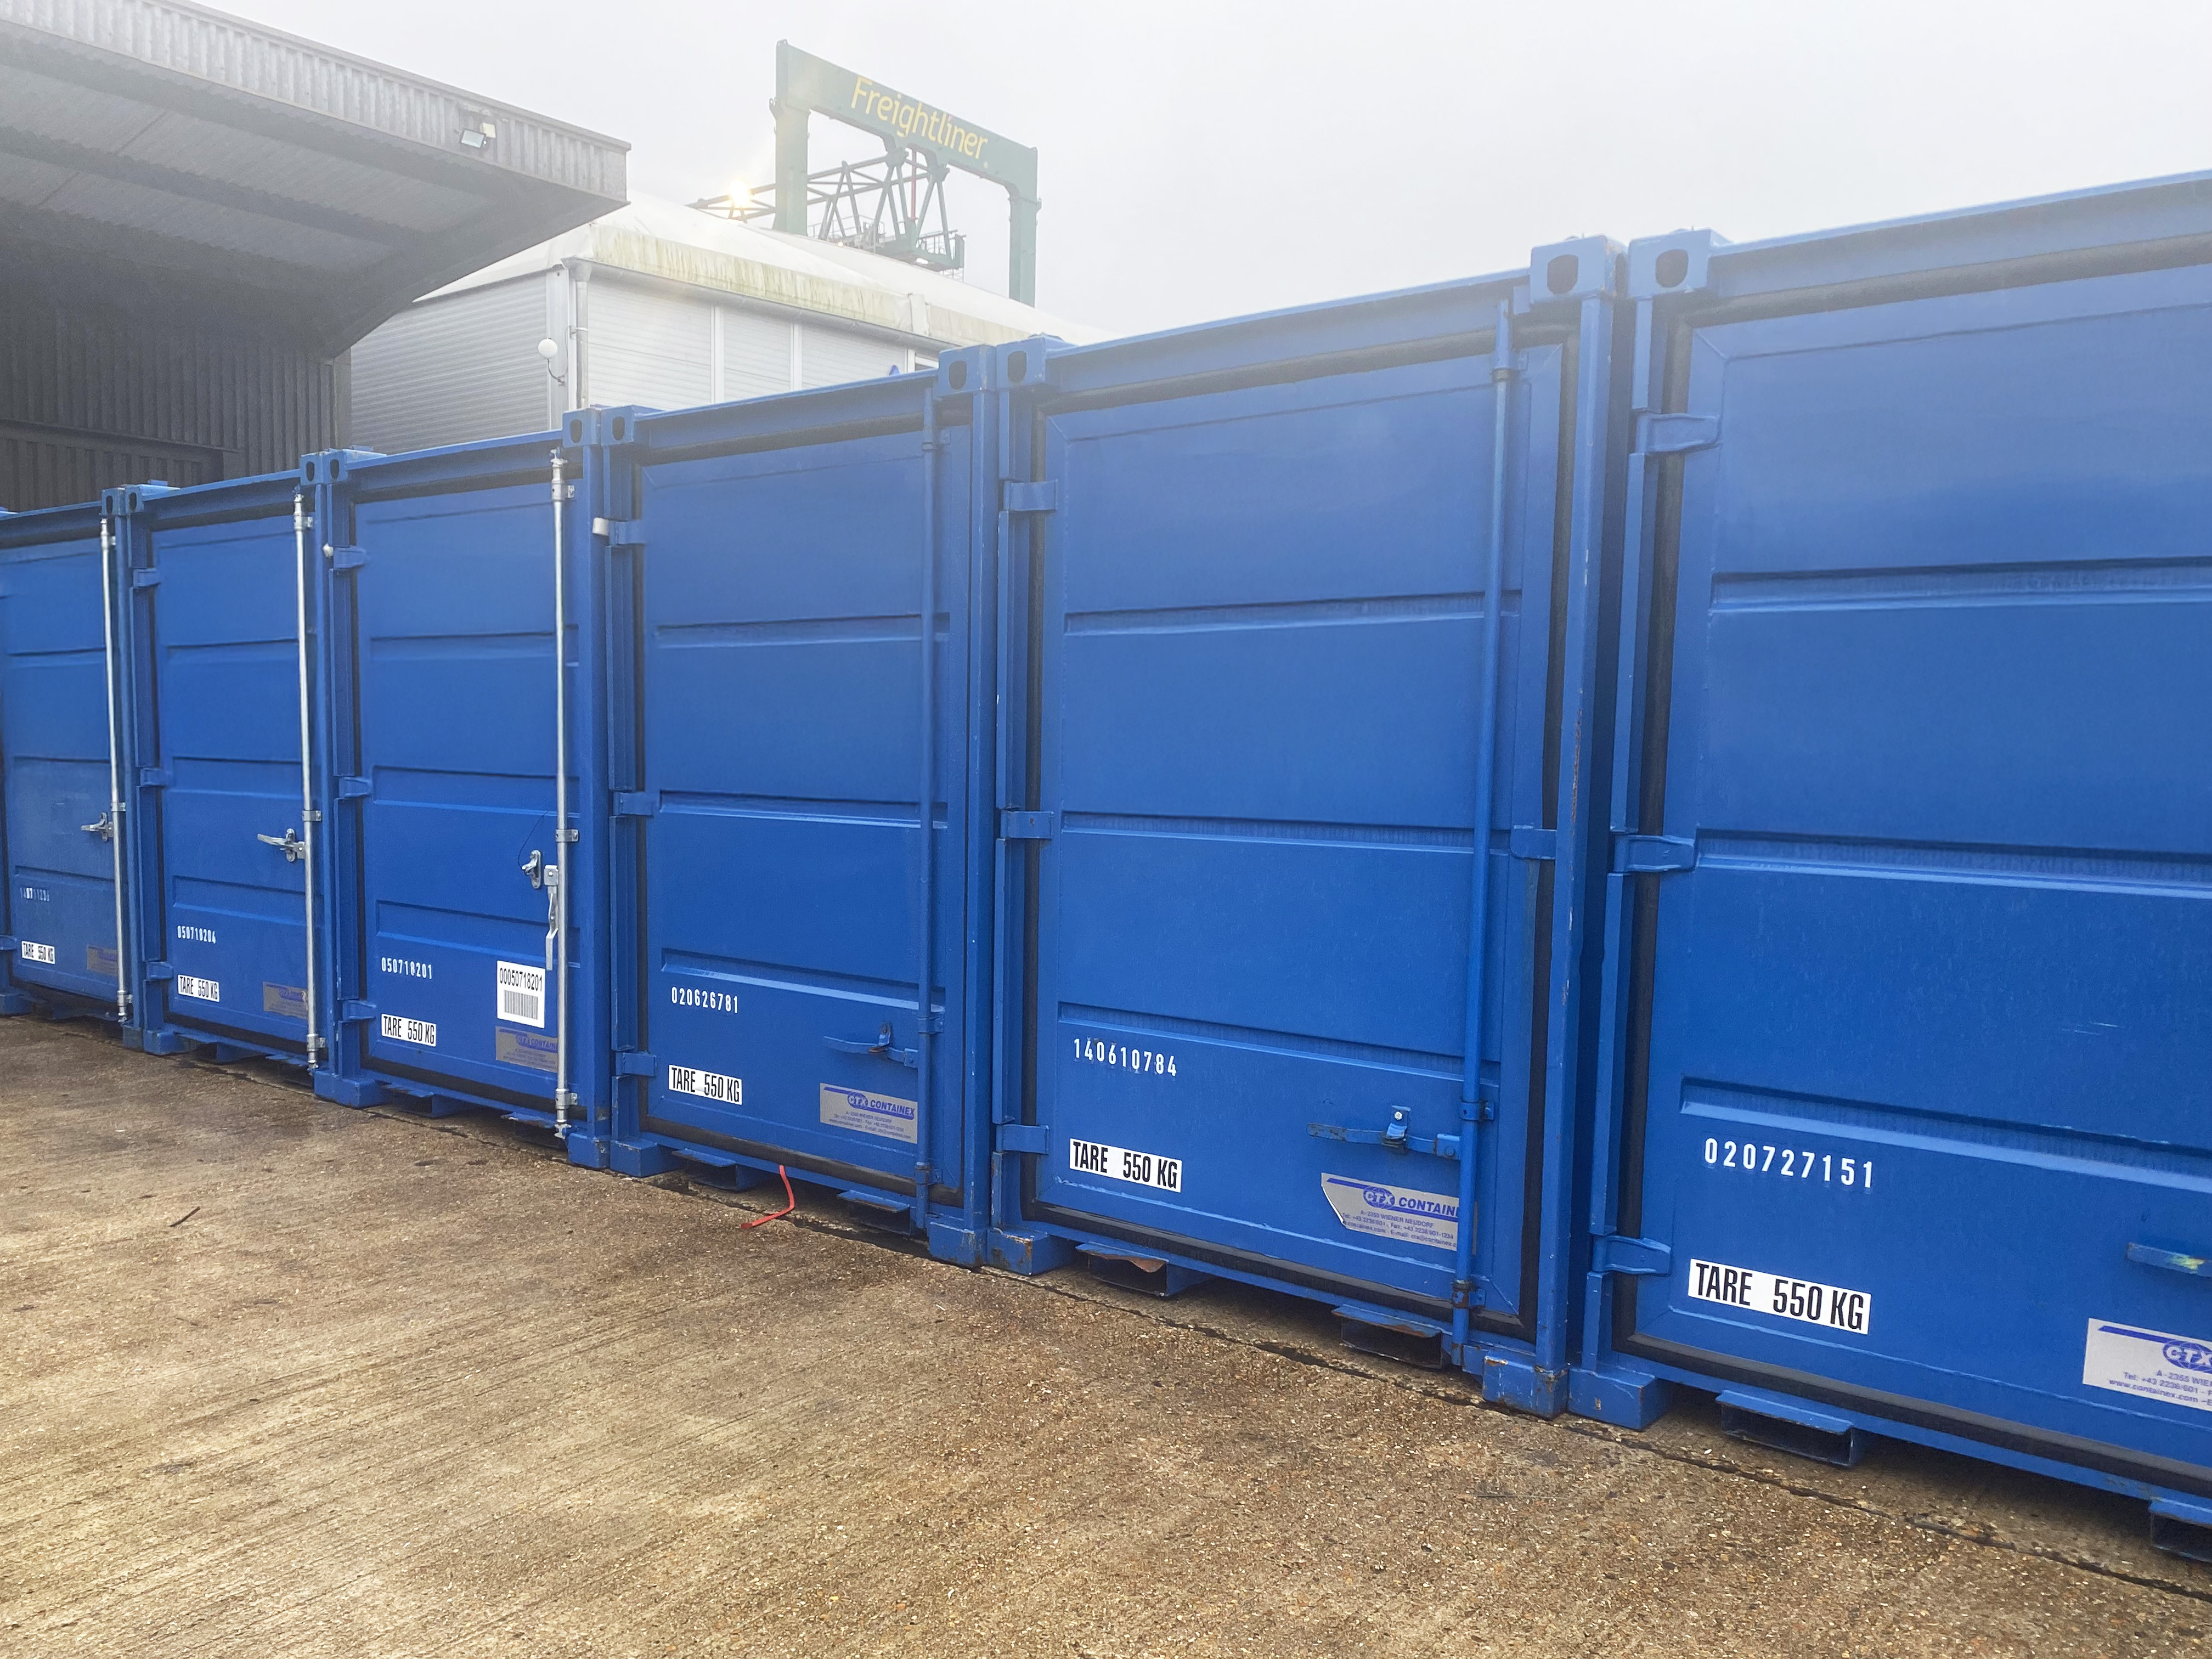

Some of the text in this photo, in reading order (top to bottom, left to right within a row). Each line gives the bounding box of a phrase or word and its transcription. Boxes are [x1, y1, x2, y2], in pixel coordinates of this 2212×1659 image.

[850, 76, 988, 160] Freightliner
[23, 943, 33, 958] TARE
[381, 957, 432, 979] 050718201
[499, 967, 543, 992] 00050718201
[180, 976, 218, 1000] TARE 550 KG
[672, 986, 738, 1014] 020626781
[383, 1015, 435, 1045] TARE 550 KG
[1074, 1038, 1177, 1077] 140610784
[672, 1066, 740, 1103] TARE 550 KG
[871, 1100, 915, 1116] CONTAINEX
[1073, 1141, 1178, 1189] TARE 550 KG
[1705, 1137, 1873, 1189] 020727151
[1365, 1191, 1458, 1216] CTX CONTAIN
[1696, 1262, 1864, 1330] TARE 550 KG
[2166, 1346, 2212, 1366] CTX
